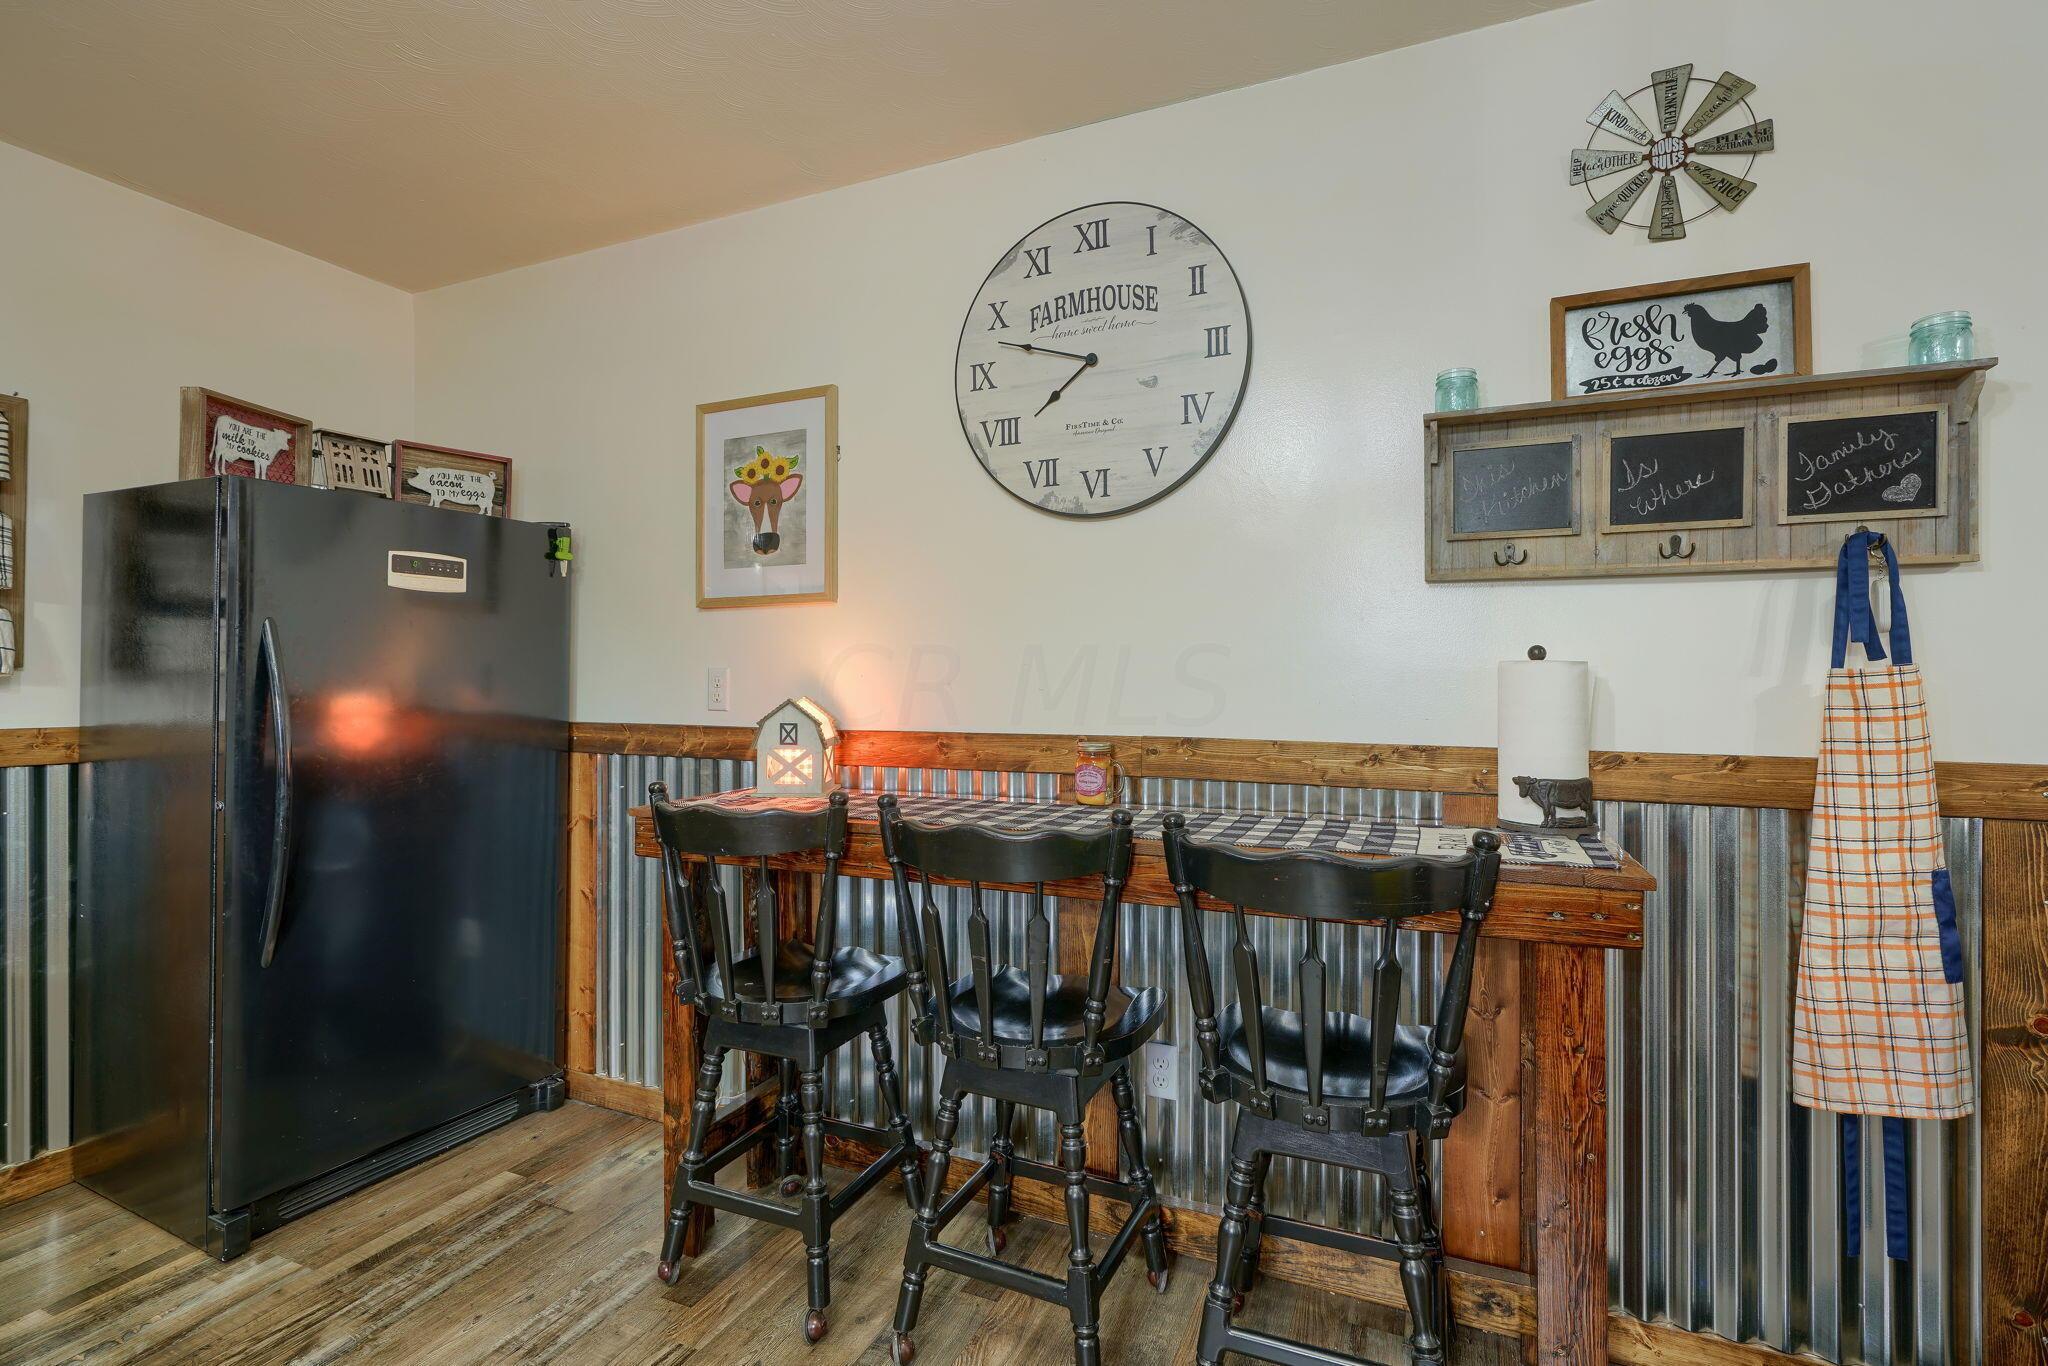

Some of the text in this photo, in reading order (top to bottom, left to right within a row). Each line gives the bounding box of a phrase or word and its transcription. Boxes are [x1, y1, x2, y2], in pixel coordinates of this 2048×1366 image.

[1606, 108, 1629, 129] KIND
[1652, 138, 1685, 155] HOUSE
[1725, 139, 1753, 149] THANK
[1755, 134, 1774, 145] YOU
[1573, 158, 1582, 176] HELP
[1604, 153, 1638, 168] OTHER
[1652, 150, 1685, 169] RULES
[1713, 178, 1748, 203] NICE
[1073, 218, 1111, 254] XII
[1146, 225, 1158, 256] I
[1023, 245, 1052, 279] XI
[1188, 264, 1208, 297] II
[987, 300, 1010, 331] X
[1030, 284, 1158, 333] FARMHOUSE
[1051, 315, 1137, 340] home sweet home
[1203, 325, 1232, 359] III
[1581, 304, 1685, 350] fresh
[1594, 338, 1675, 373] eggs
[969, 361, 998, 392] IX
[1624, 378, 1636, 386] a
[1636, 373, 1681, 386] dozen
[1180, 391, 1215, 425] IV
[222, 432, 245, 445] milk
[229, 422, 240, 431] YOU
[979, 416, 1021, 448] VIII
[236, 445, 270, 461] cookies
[1142, 446, 1168, 477] V
[1795, 429, 1899, 481] Family
[429, 474, 463, 488] bacon
[437, 472, 450, 480] YOU
[1022, 458, 1060, 489] VII
[1079, 468, 1111, 499] VI
[1618, 458, 1658, 492] Is
[1803, 448, 1922, 510] Gathers
[449, 490, 460, 498] MY
[461, 489, 486, 501] eggs
